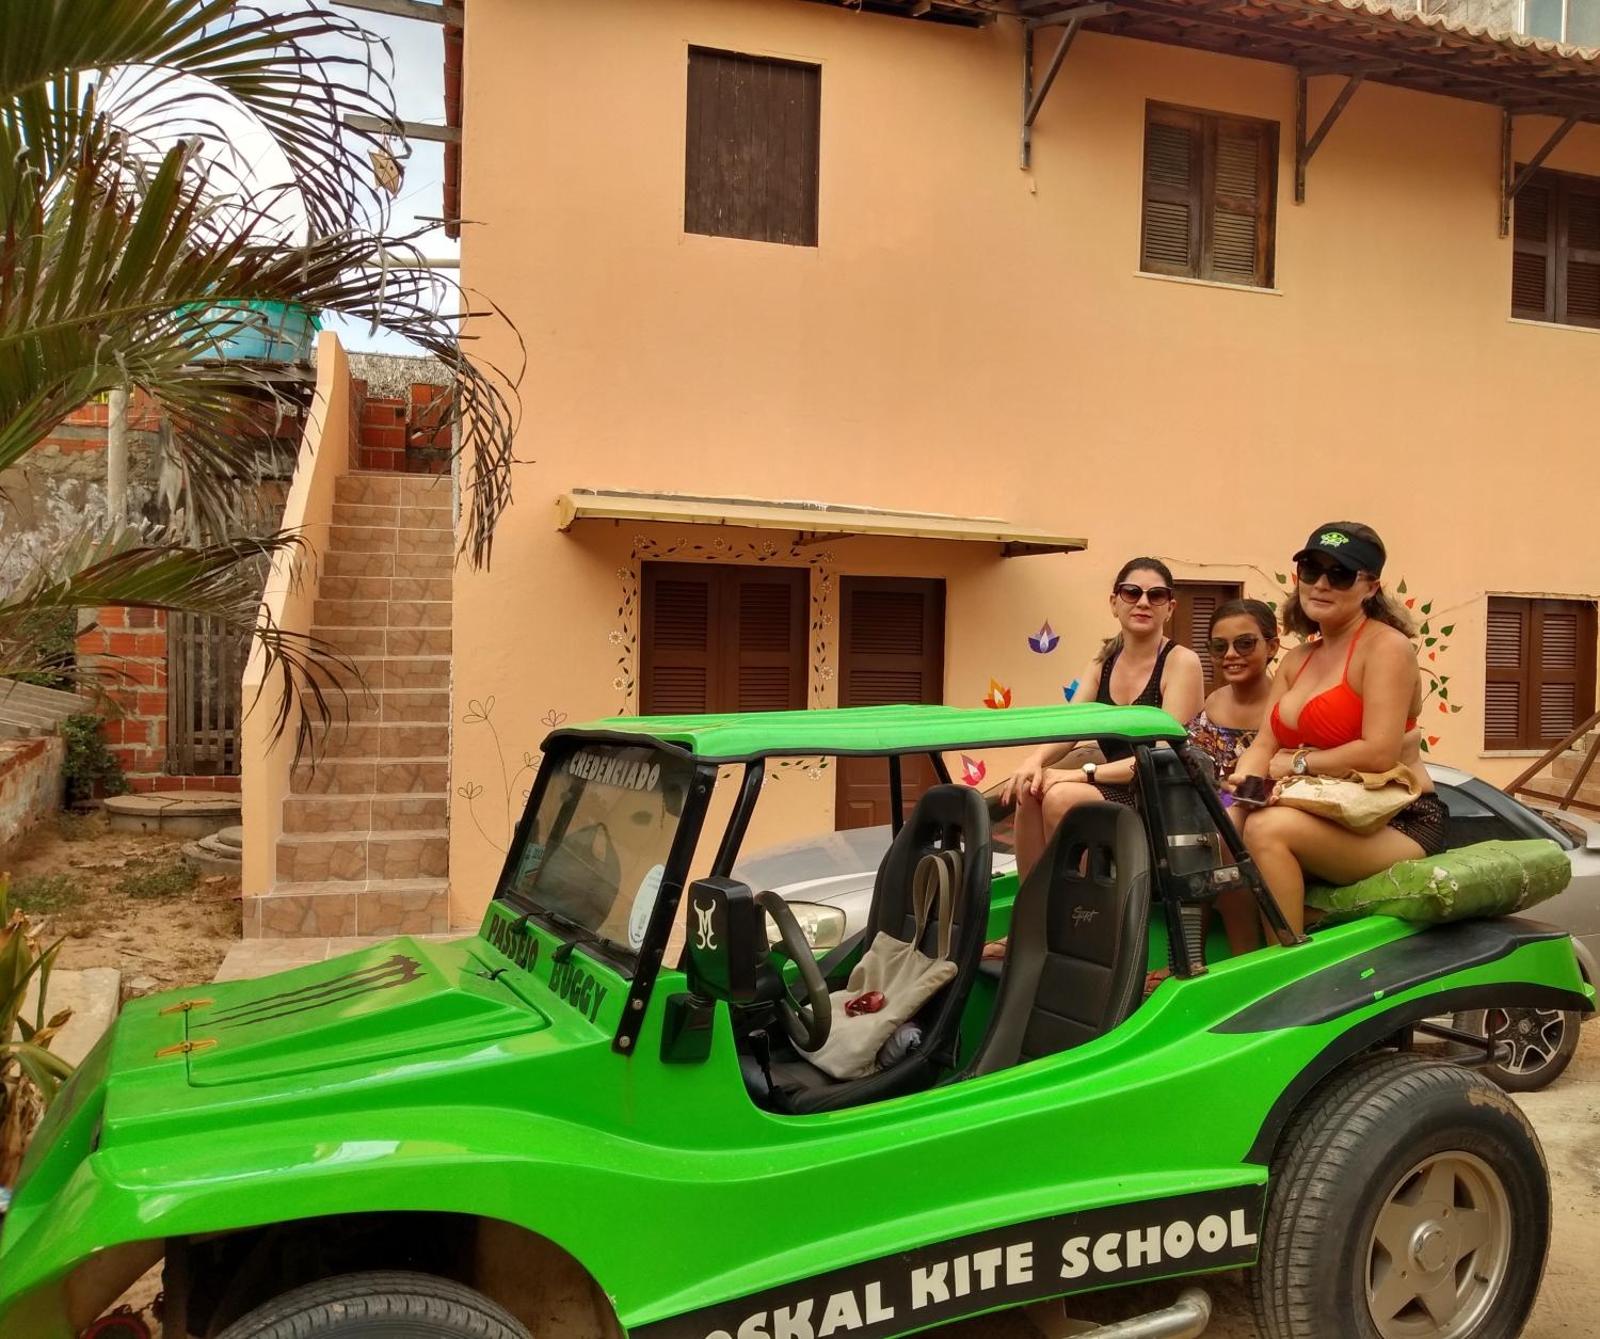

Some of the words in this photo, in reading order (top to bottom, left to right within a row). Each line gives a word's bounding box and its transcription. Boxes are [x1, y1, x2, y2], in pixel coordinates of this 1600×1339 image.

[569, 751, 660, 792] CREDENCIADO
[548, 961, 608, 1024] BUGGY
[704, 1281, 895, 1339] SKAL
[911, 1241, 1034, 1310] KITE
[1059, 1208, 1258, 1279] SCHOOL
